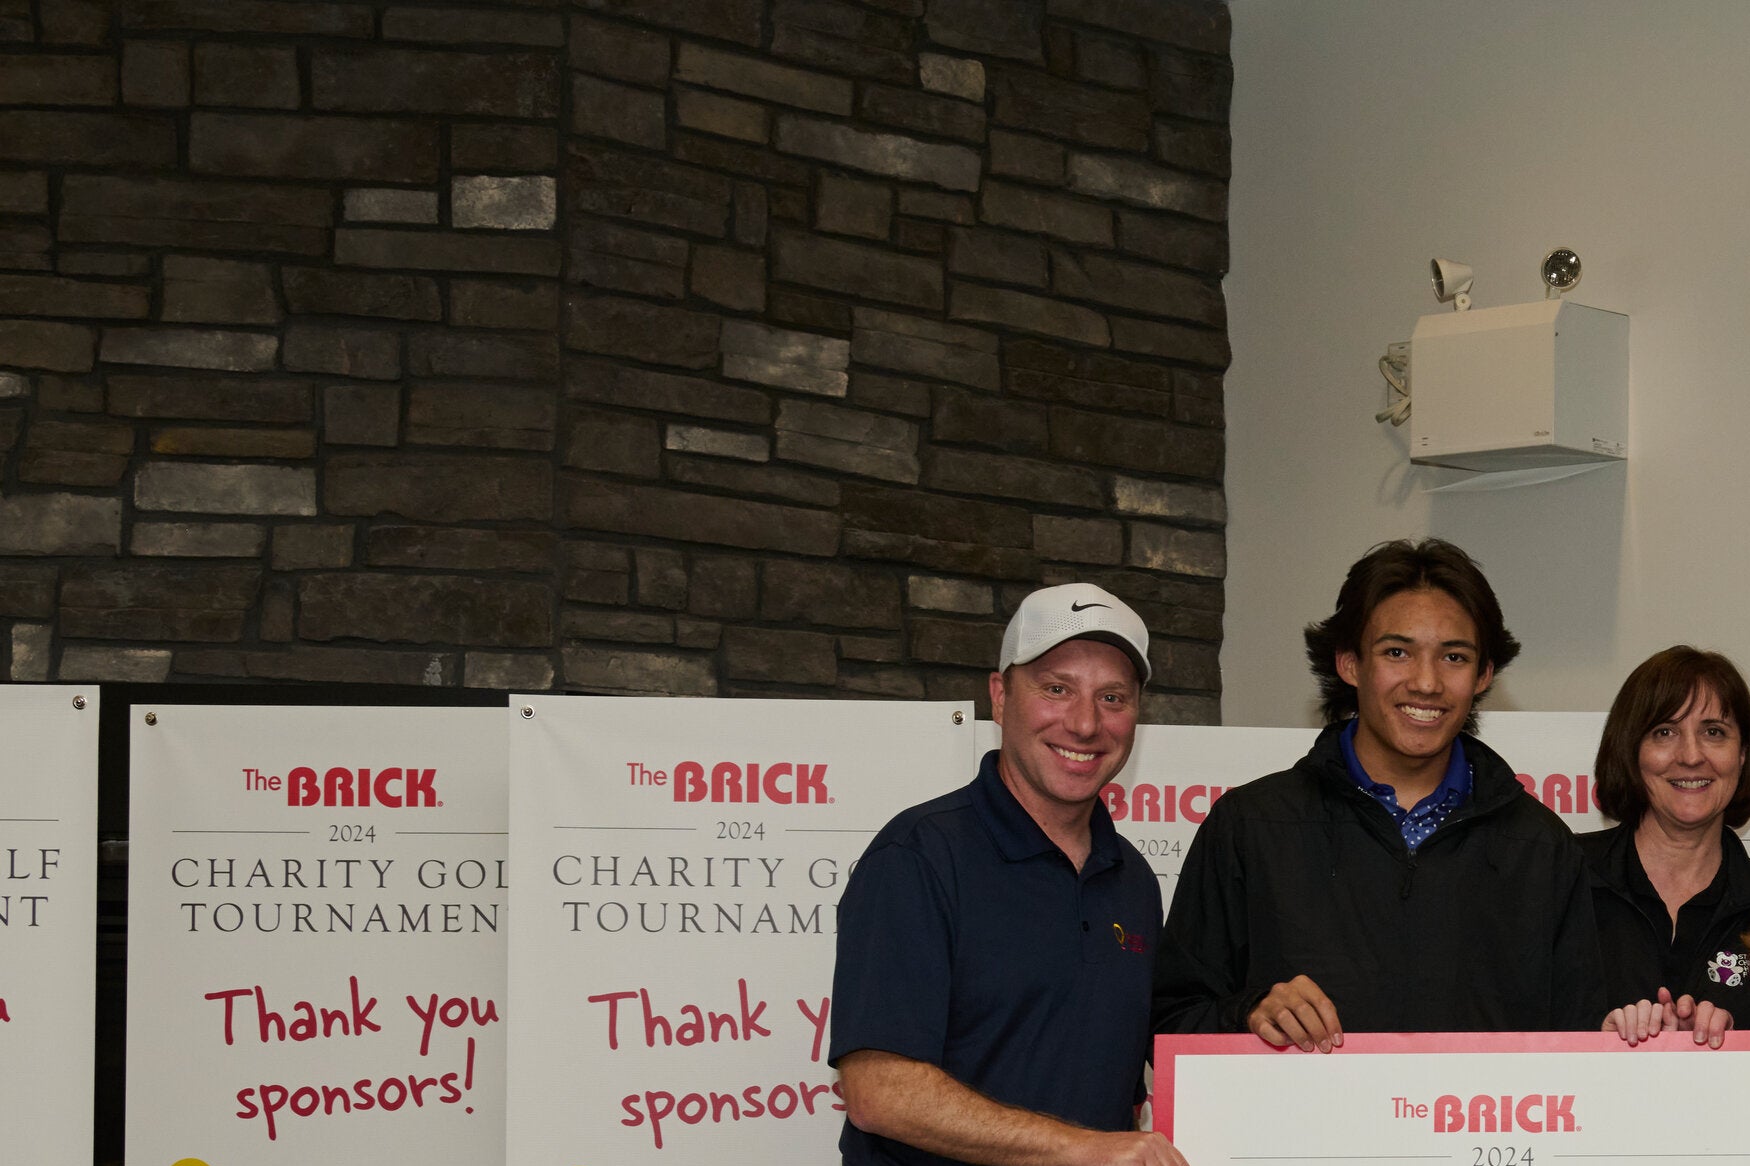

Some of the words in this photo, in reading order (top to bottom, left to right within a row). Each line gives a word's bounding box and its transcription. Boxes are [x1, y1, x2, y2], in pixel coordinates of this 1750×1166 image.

[242, 768, 282, 791] The
[287, 766, 438, 808] BRICK
[627, 763, 667, 786] The
[673, 761, 829, 804] BRICK
[1099, 783, 1232, 824] BRIC
[328, 824, 376, 844] 2024
[716, 821, 766, 841] 2024
[1137, 839, 1182, 858] 2024
[171, 858, 395, 889] CHARITY
[417, 859, 508, 889] GOL
[553, 855, 785, 888] CHARITY
[180, 903, 509, 934] TOURNAMEN
[205, 976, 381, 1046] Thank
[406, 992, 500, 1057] you
[588, 978, 772, 1051] Thank
[235, 1037, 476, 1142] sponsors!
[1391, 1097, 1428, 1120] The
[1433, 1094, 1577, 1134] BRICK
